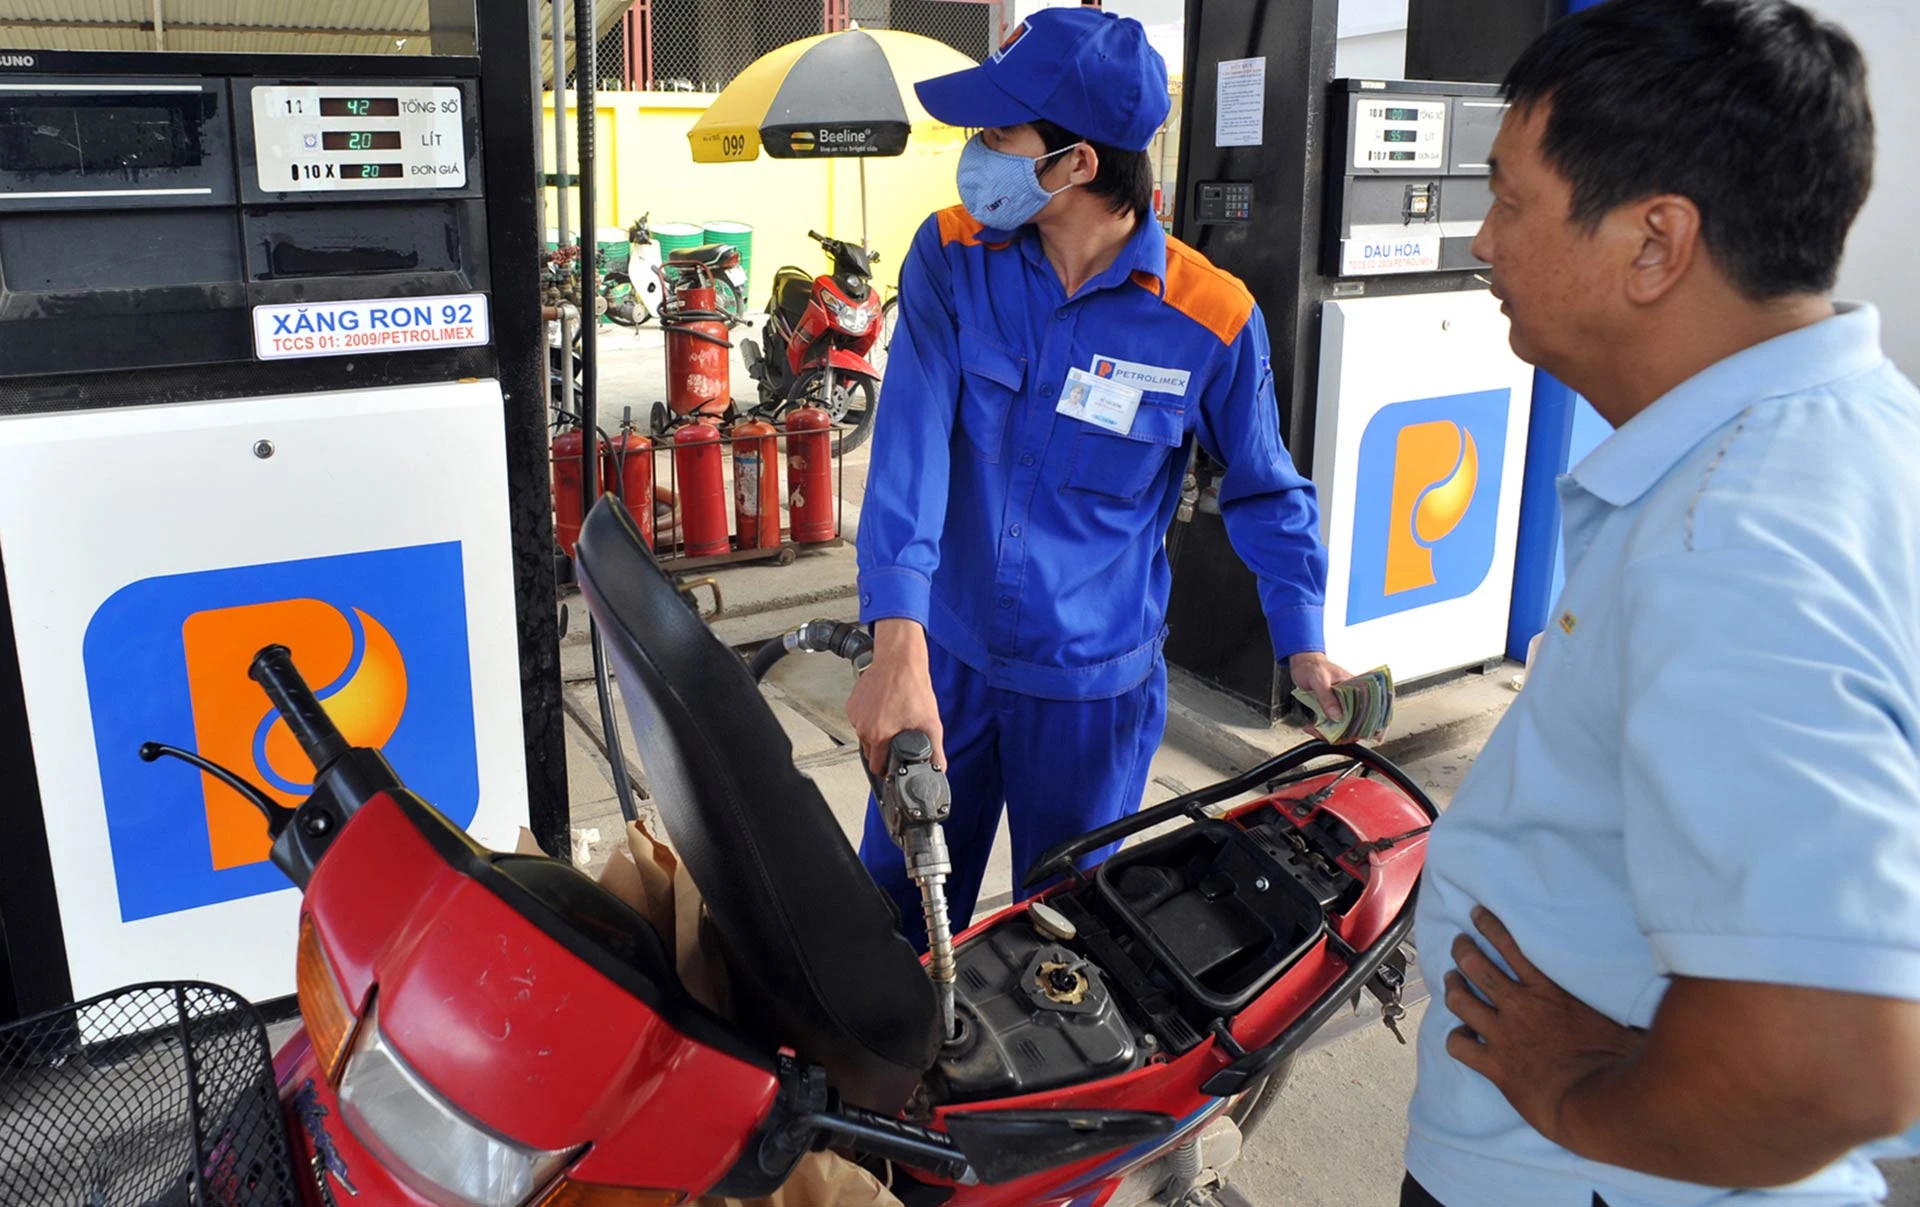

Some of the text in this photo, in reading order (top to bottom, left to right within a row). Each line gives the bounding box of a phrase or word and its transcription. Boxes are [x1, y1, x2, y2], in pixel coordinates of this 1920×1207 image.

[0, 55, 34, 67] UNO
[347, 99, 370, 115] 42
[421, 130, 442, 146] LÍT
[723, 135, 745, 156] 099
[303, 163, 335, 179] 10 X
[361, 165, 380, 178] 20
[439, 162, 460, 175] GIÁ
[272, 304, 472, 335] XĂNG RON 92
[272, 327, 474, 352] TCCS 01: 2009/PETROLIMEX
[1115, 369, 1185, 387] PETROLIMEX
